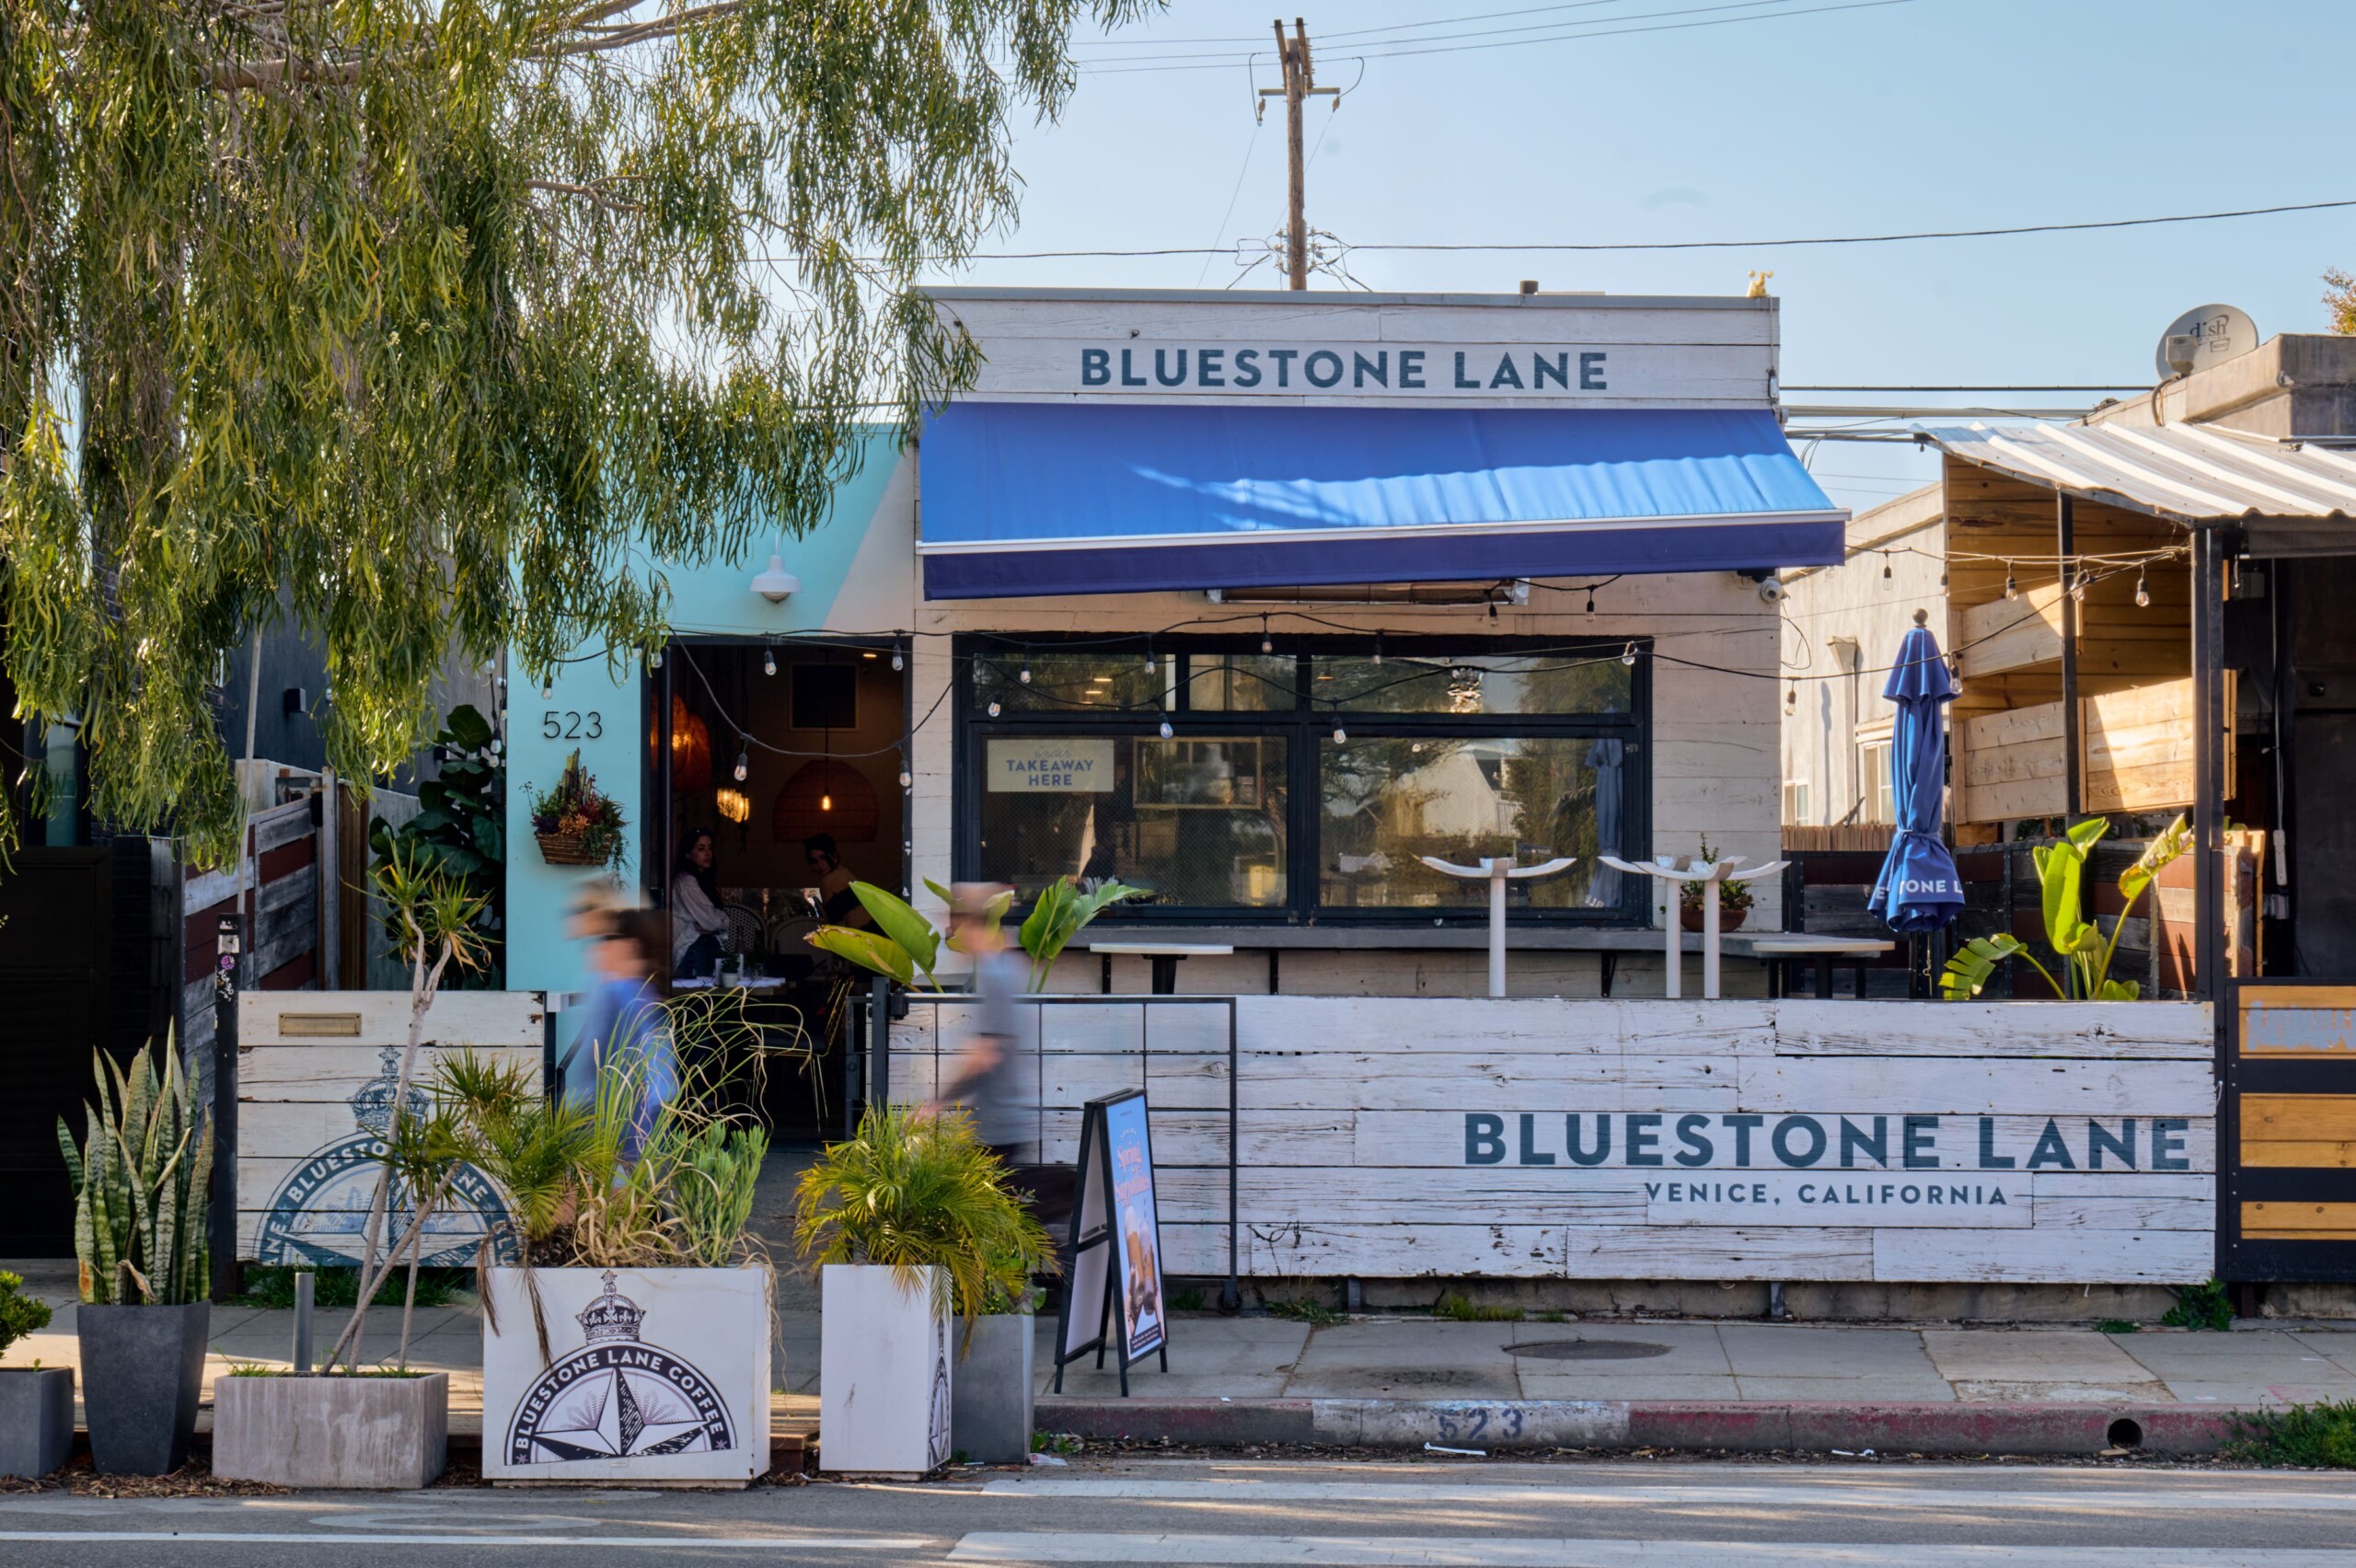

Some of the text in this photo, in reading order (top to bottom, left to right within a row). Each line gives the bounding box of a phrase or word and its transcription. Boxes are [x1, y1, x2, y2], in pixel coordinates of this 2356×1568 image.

[1081, 348, 1608, 391] BLUESTONE LANE
[543, 710, 603, 740] 523
[1005, 759, 1095, 772] TAKEAWAY
[1028, 774, 1073, 787] HERE
[1464, 1113, 2190, 1170] BLUESTONE LANE
[286, 1140, 388, 1204] BLUESTO
[1644, 1182, 2008, 1206] VENICE, CALIFORNIA
[514, 1349, 725, 1450] BLUESTONE LANE COFFEE
[1438, 1407, 1523, 1440] 523
